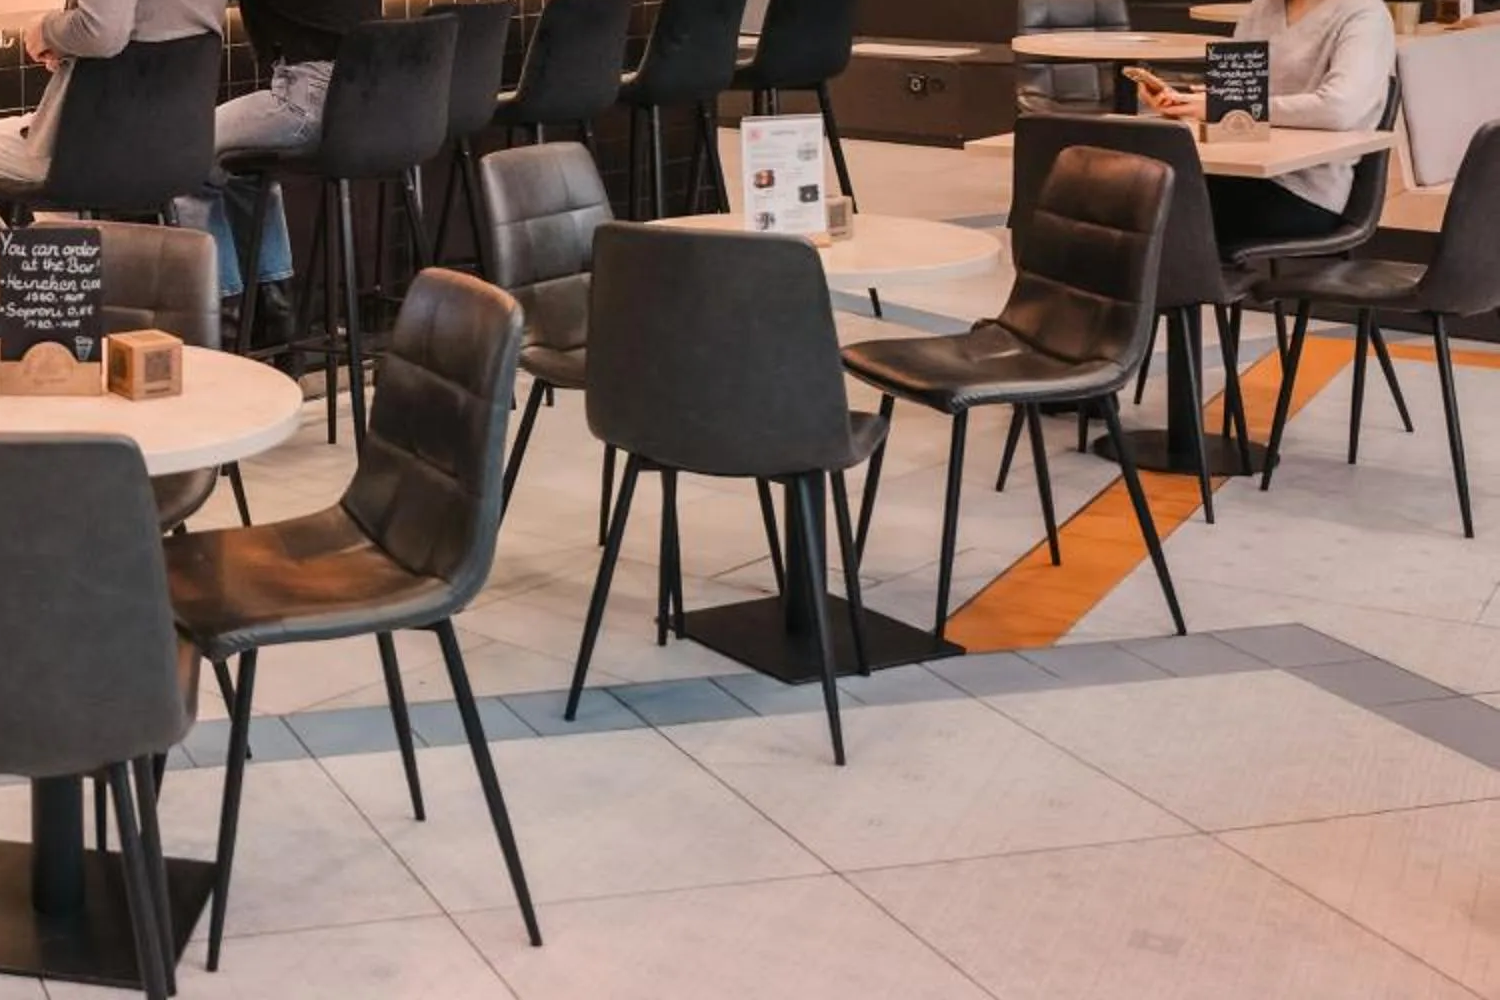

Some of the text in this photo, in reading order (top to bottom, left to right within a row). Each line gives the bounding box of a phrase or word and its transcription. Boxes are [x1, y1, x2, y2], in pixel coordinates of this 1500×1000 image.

[0, 232, 99, 257] You can order
[21, 258, 38, 272] at
[43, 258, 65, 272] the
[6, 301, 64, 321] Soproni
